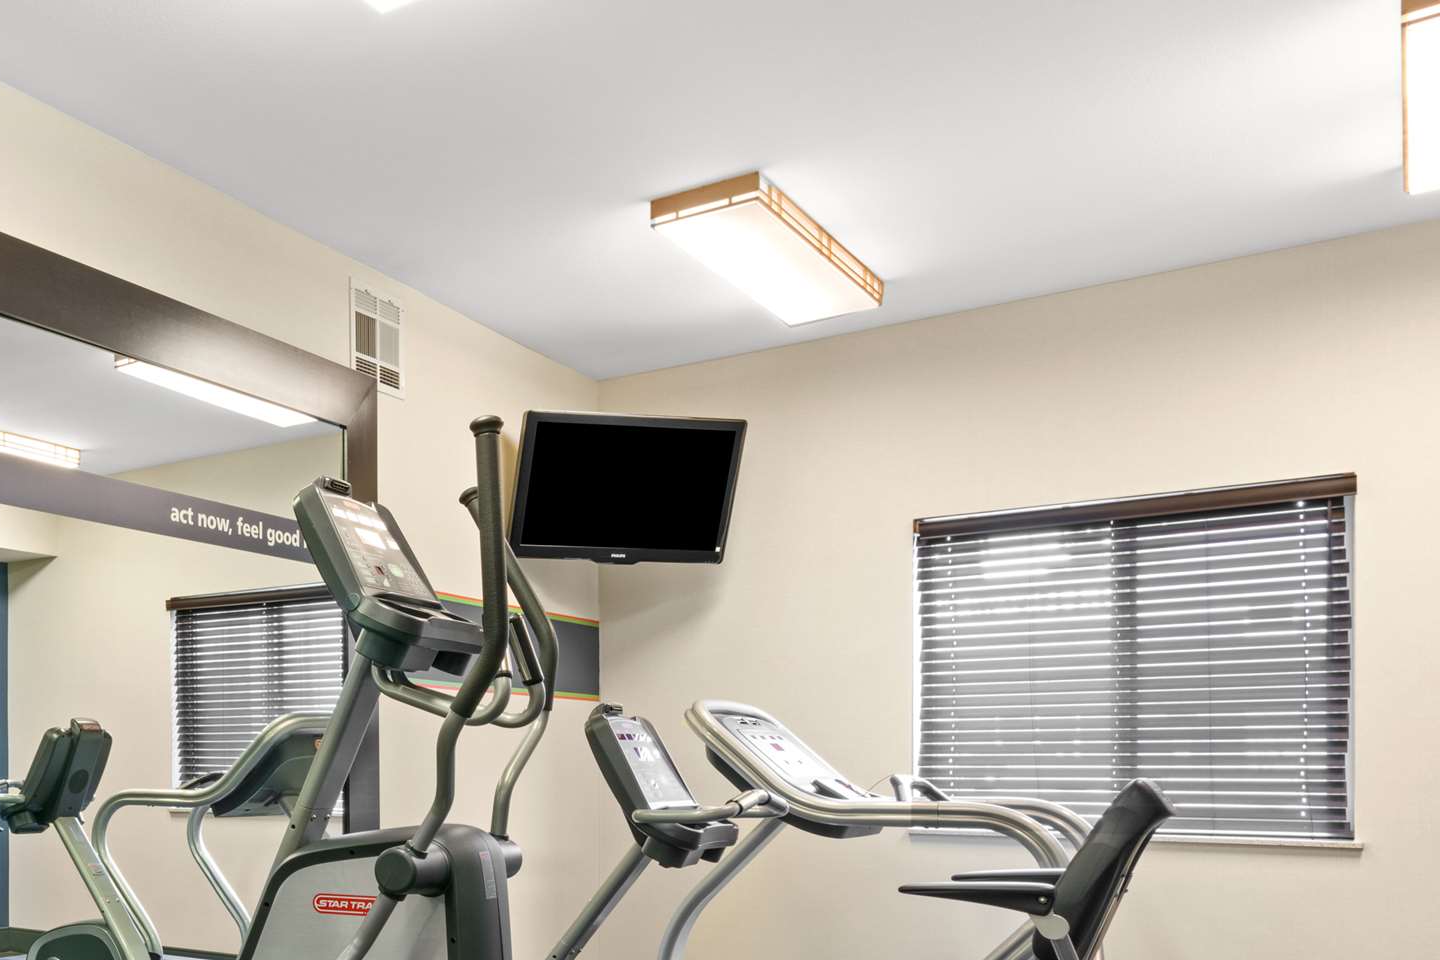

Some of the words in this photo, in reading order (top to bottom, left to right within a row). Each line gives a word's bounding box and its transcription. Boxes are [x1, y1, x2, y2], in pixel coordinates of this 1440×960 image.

[170, 507, 194, 525] act
[197, 513, 233, 536] now,
[236, 516, 263, 540] feel
[266, 527, 300, 547] good
[319, 899, 349, 909] STAR
[350, 901, 373, 910] TRA
